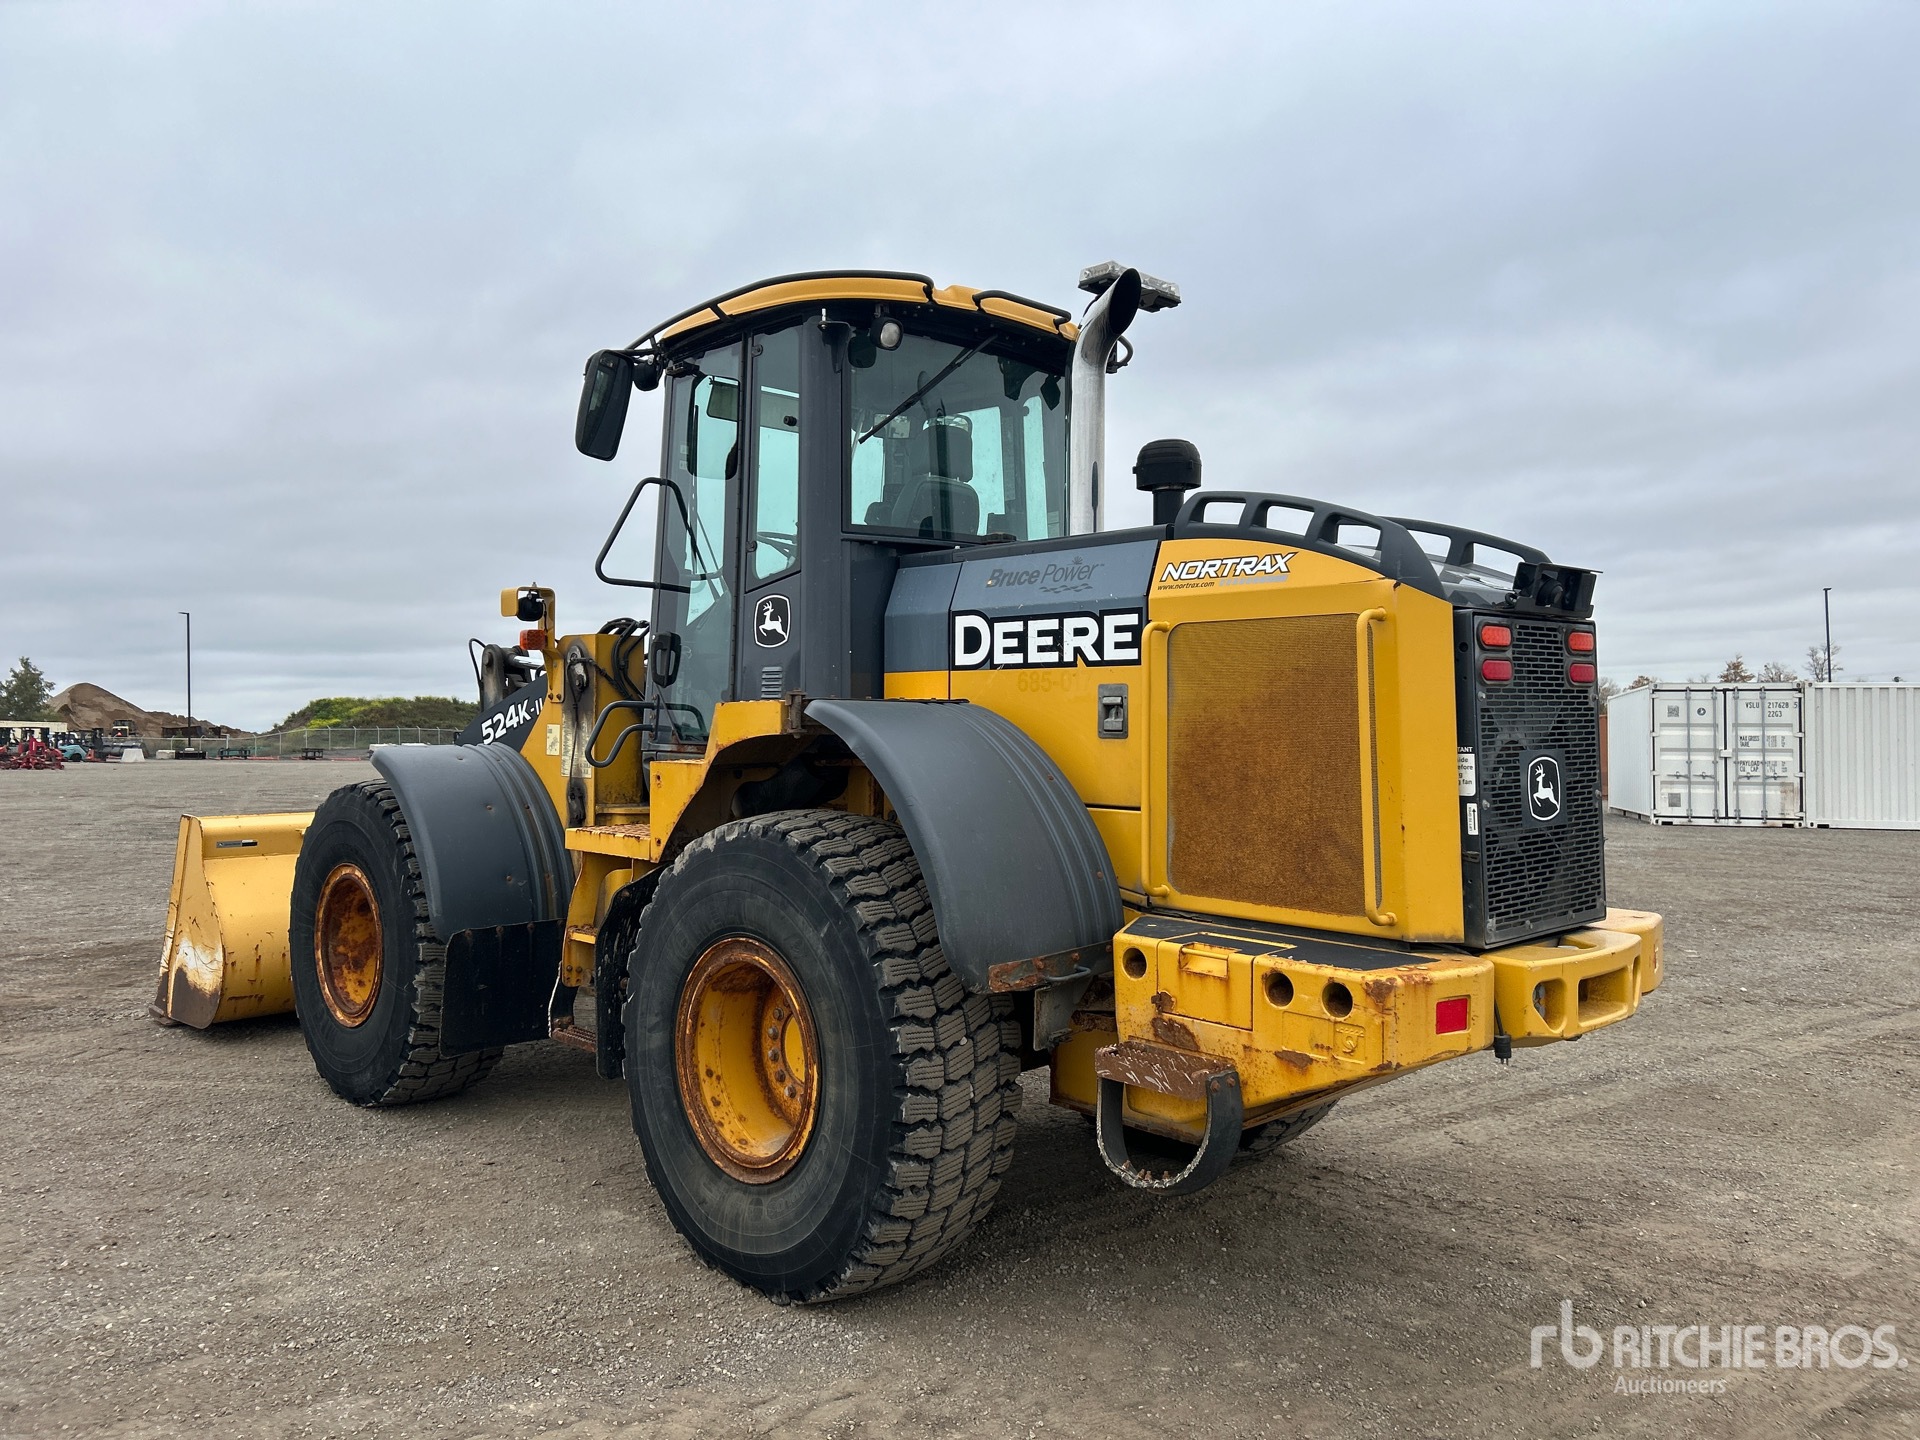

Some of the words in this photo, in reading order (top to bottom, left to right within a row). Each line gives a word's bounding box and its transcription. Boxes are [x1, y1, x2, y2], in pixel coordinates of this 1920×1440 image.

[986, 568, 1040, 588] Bruce
[1040, 563, 1099, 584] Power
[1159, 552, 1298, 582] NORTRAX
[1157, 581, 1215, 591] www.nortrax.com
[954, 612, 1139, 667] DEERE
